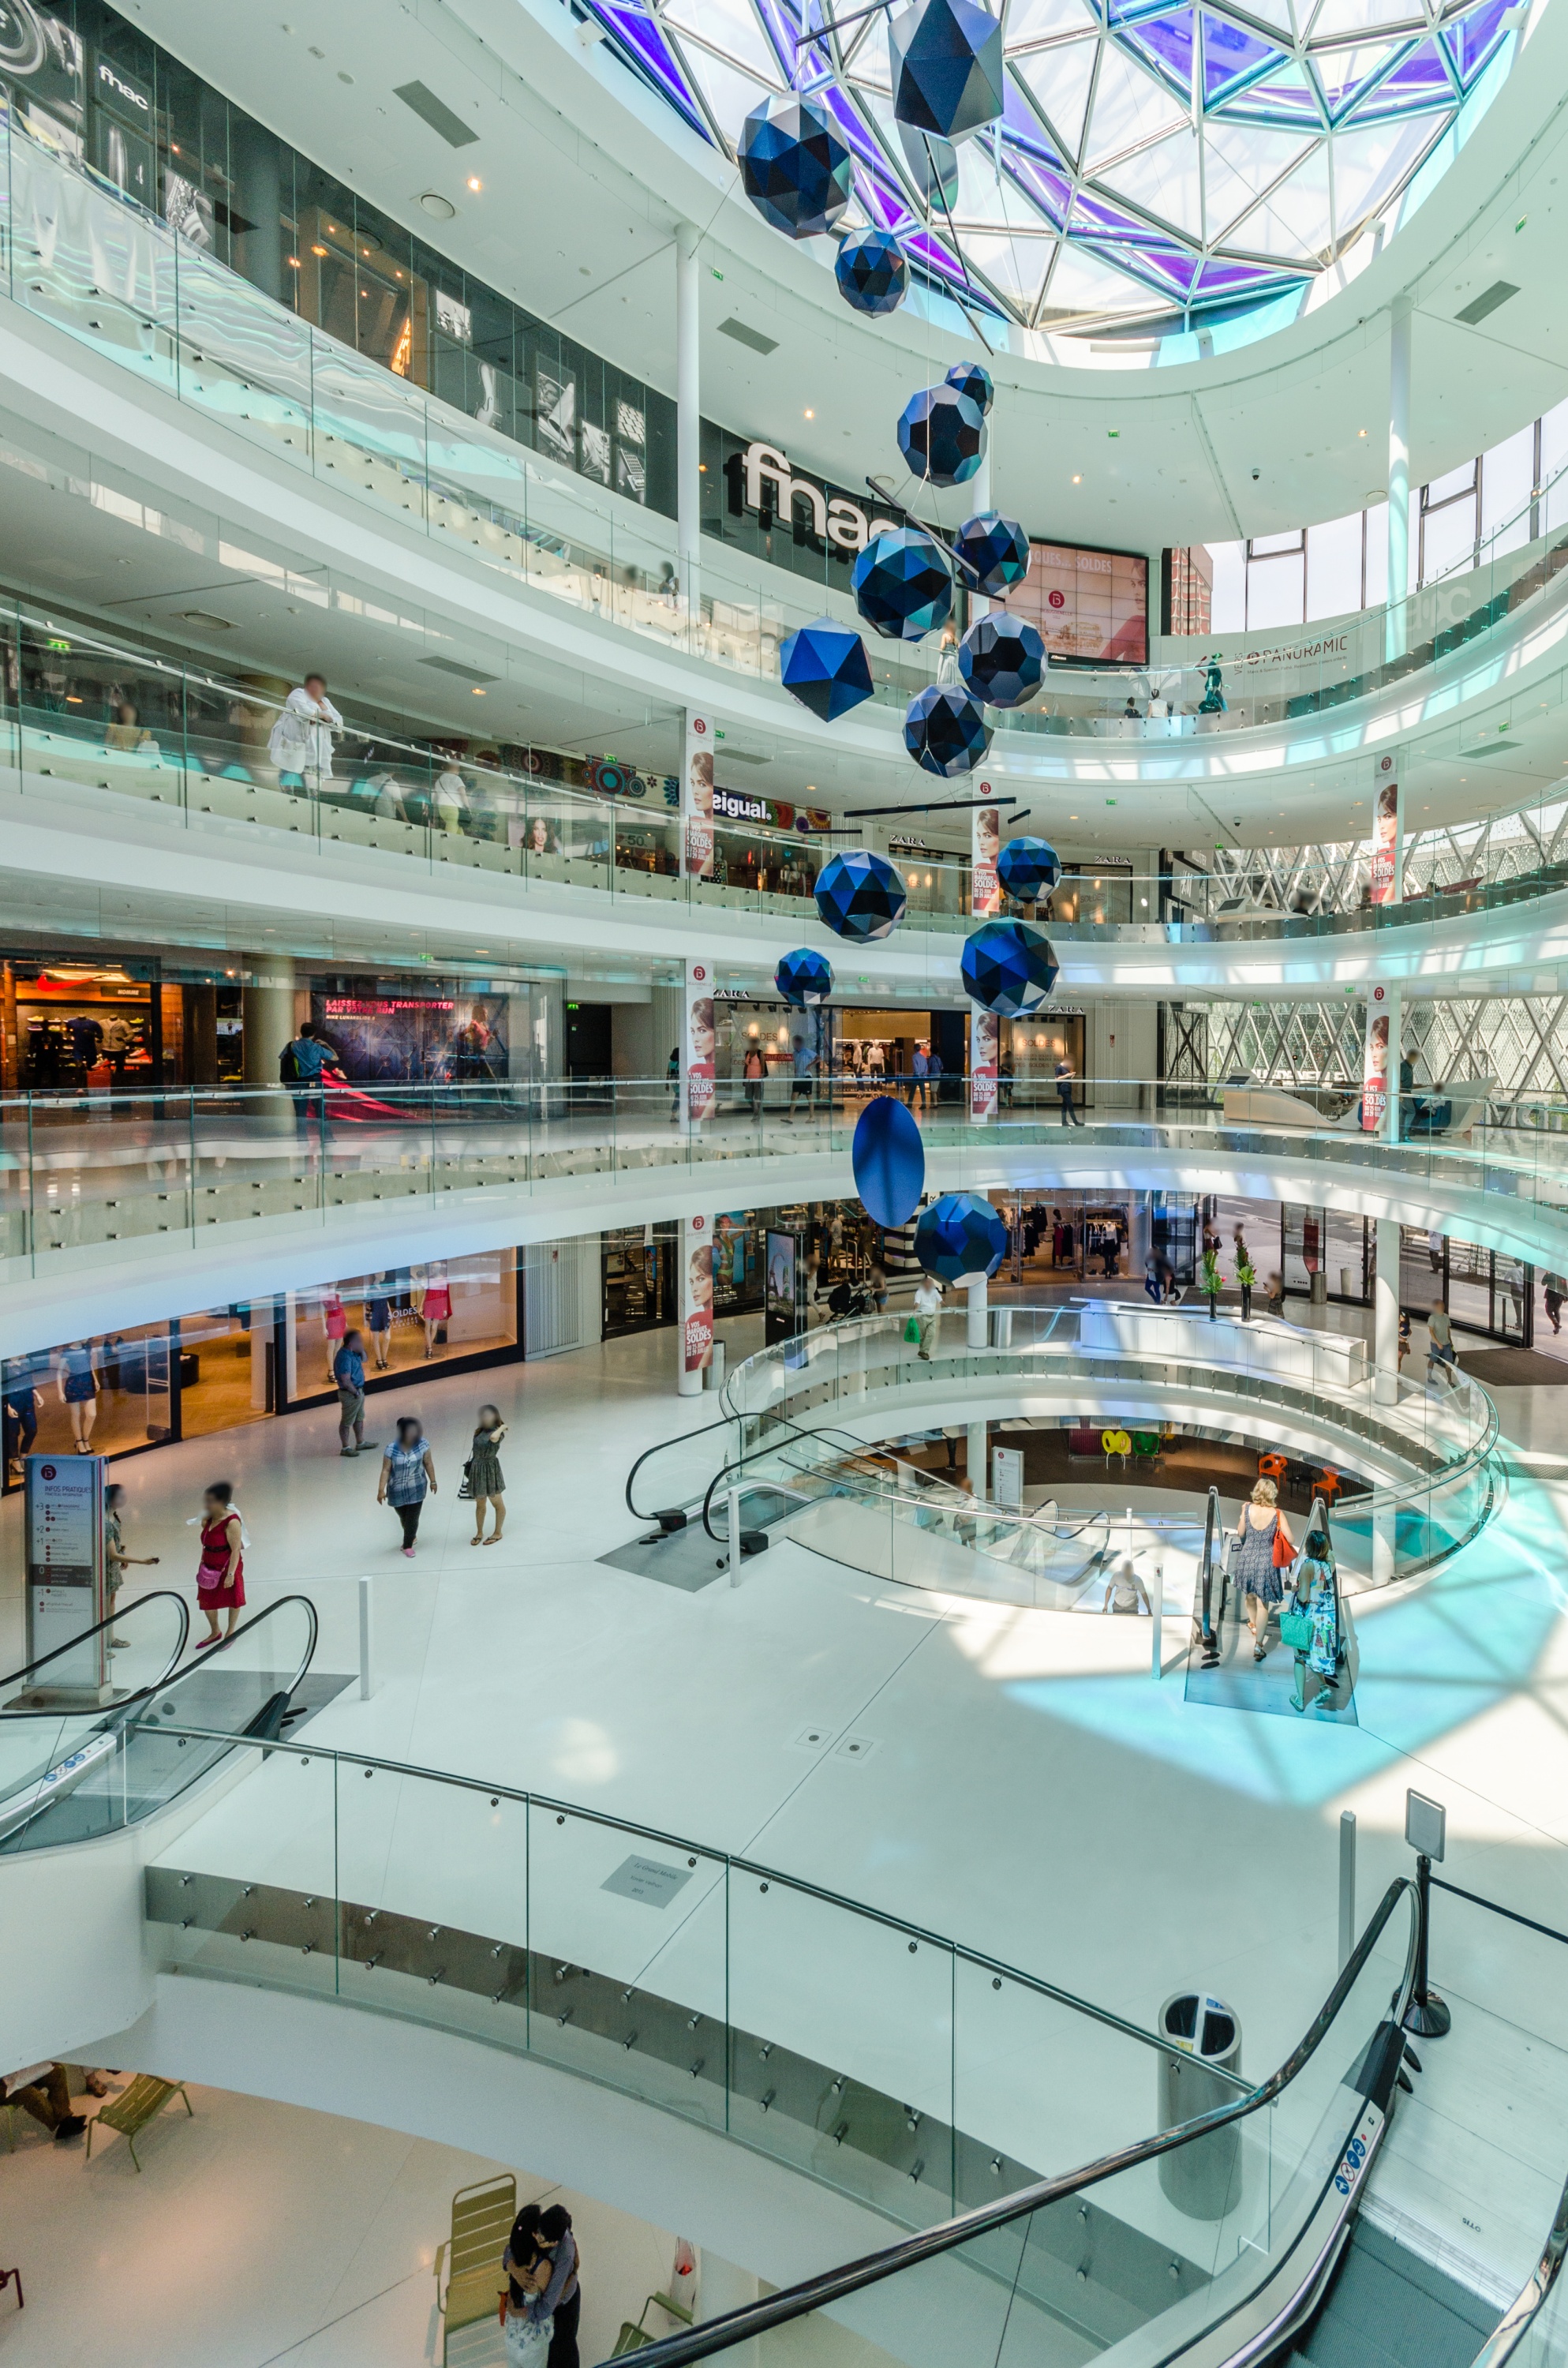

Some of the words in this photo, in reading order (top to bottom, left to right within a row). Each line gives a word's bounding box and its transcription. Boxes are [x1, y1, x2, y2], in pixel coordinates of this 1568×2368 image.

[99, 66, 148, 110] fnac
[1076, 556, 1112, 573] SOLDES
[890, 834, 926, 847] ZARA
[1095, 856, 1132, 864] ZARA
[1373, 866, 1394, 878] SOLDES
[974, 879, 997, 889] SOLDES
[1080, 894, 1106, 903] SOLDES
[391, 1001, 454, 1010] TRANSPORTER
[1048, 1005, 1085, 1014] ZARA
[1022, 1039, 1056, 1047] SOLDES
[973, 1083, 997, 1092] SOLDES
[387, 1306, 417, 1320] SOLDES
[687, 1328, 712, 1345] SOLDES
[36, 1502, 44, 1511] +3
[36, 1525, 44, 1534] +2
